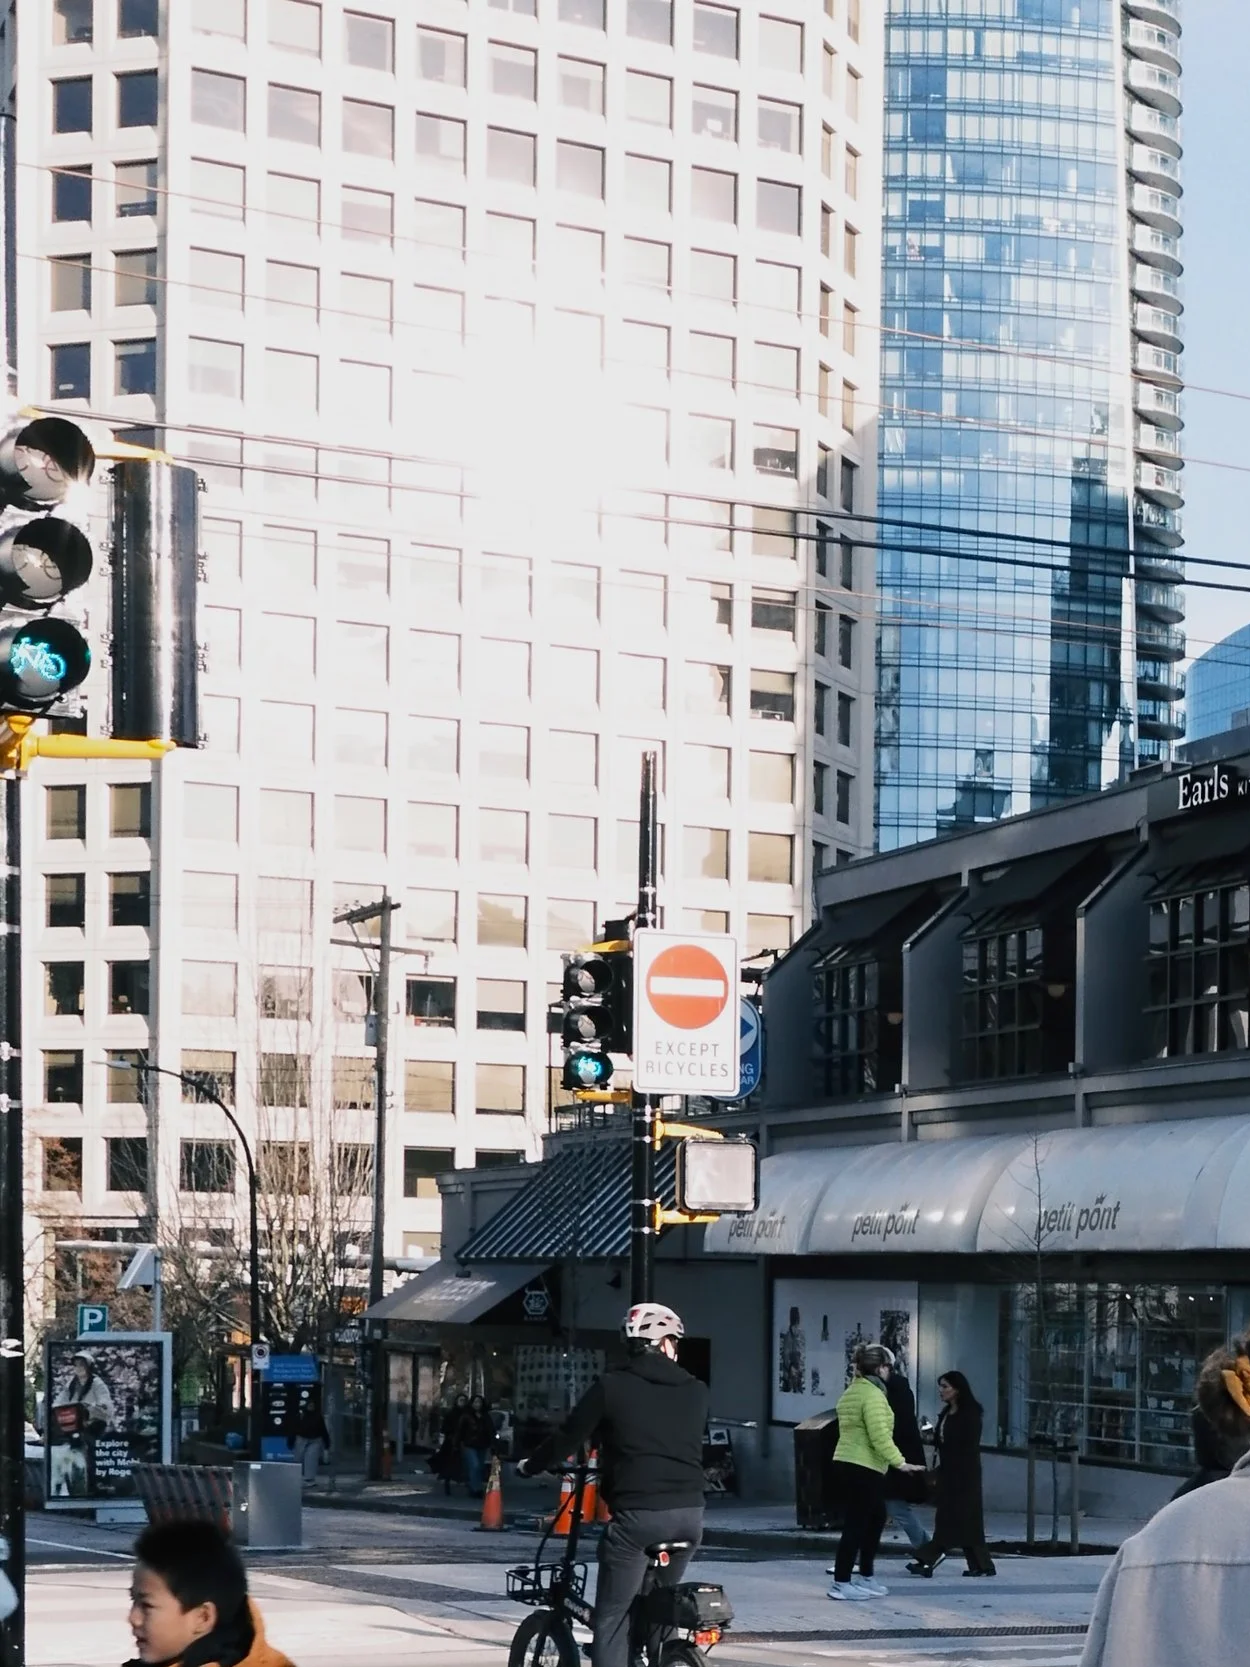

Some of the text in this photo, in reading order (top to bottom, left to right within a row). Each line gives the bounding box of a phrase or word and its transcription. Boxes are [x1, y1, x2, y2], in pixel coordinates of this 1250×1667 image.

[1178, 764, 1229, 810] Earls
[655, 1041, 720, 1057] EXCEPT
[646, 1060, 729, 1077] BICYCLES
[851, 1212, 883, 1242] petit
[1034, 1202, 1075, 1240] petit
[83, 1308, 103, 1331] P
[95, 1439, 129, 1449] Explore
[95, 1448, 128, 1458] the city
[95, 1458, 115, 1466] with
[95, 1468, 131, 1477] by Roge
